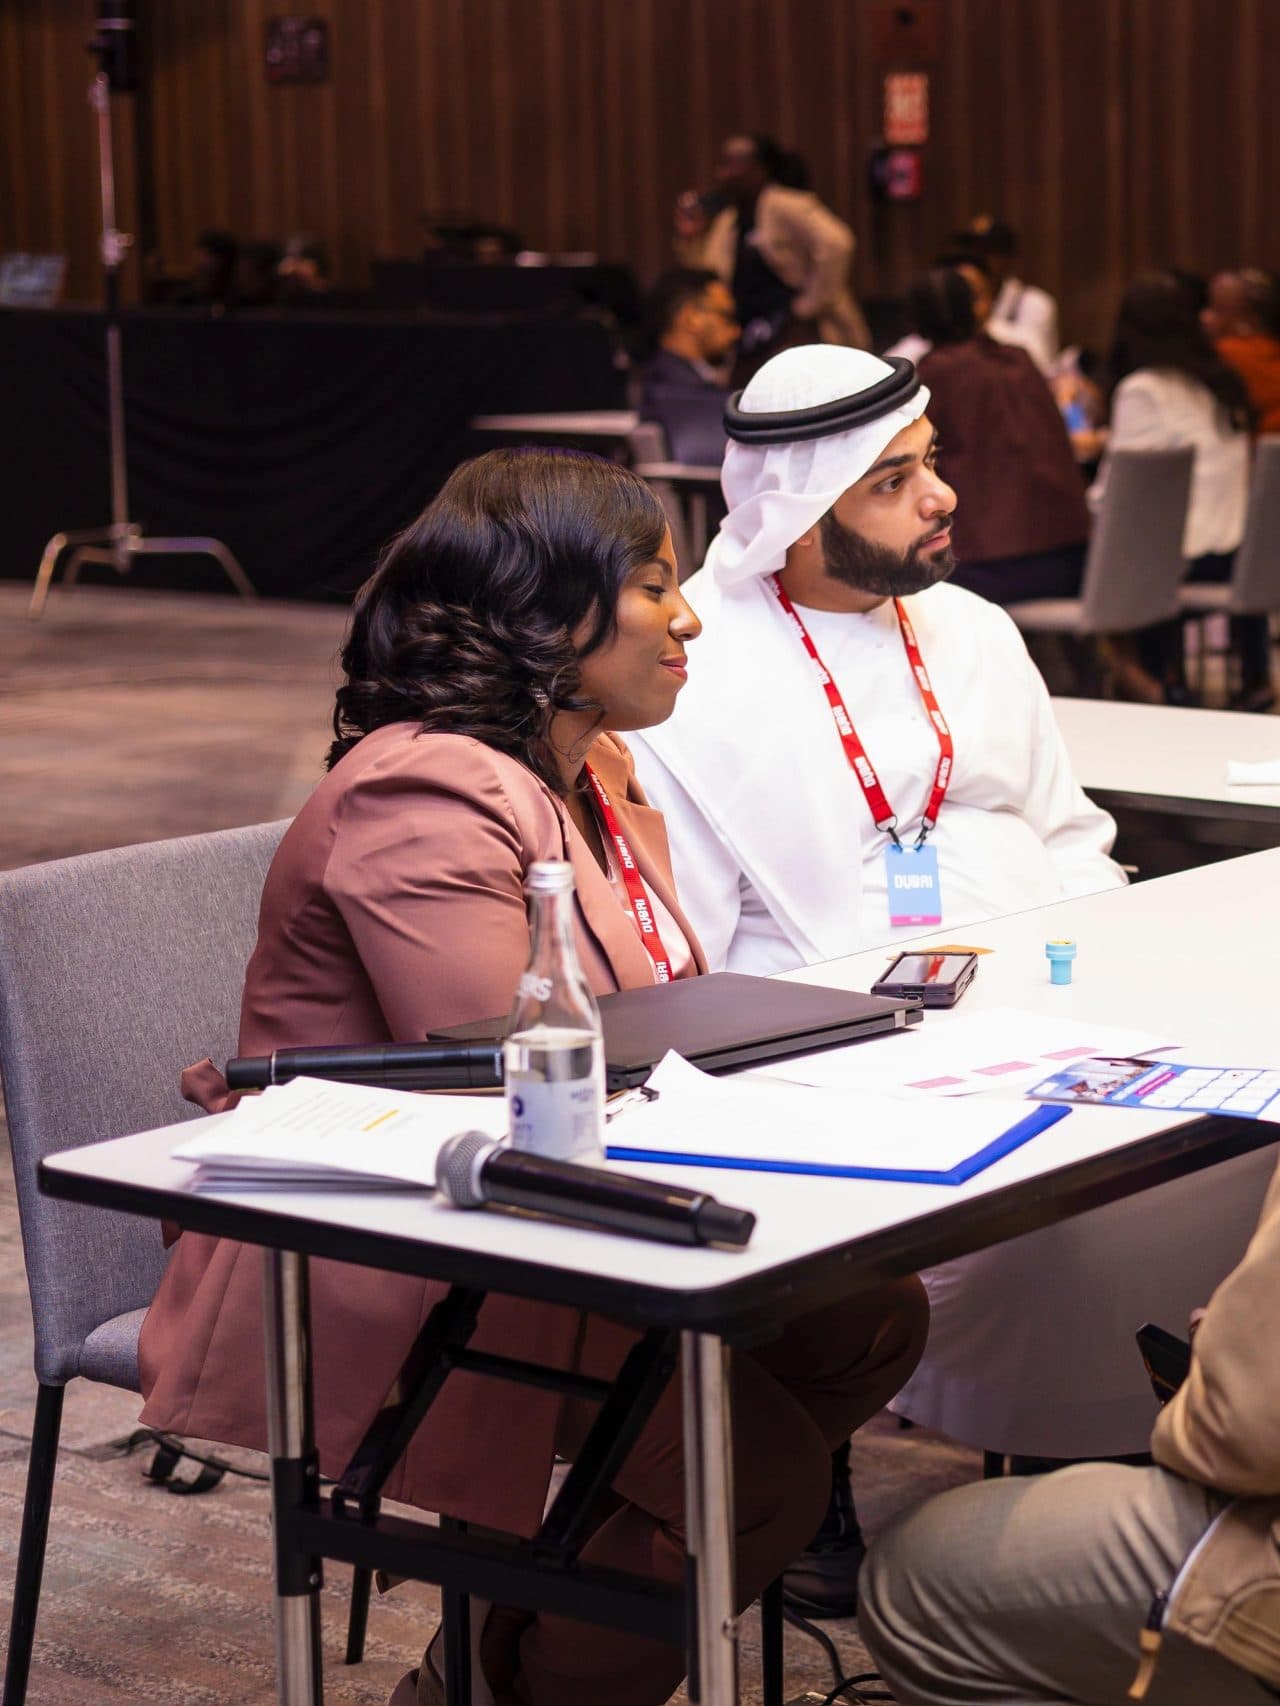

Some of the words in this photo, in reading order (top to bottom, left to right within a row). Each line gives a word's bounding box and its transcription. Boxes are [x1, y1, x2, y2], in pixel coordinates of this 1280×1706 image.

[616, 836, 634, 869] DUBAI
[894, 874, 933, 889] DUBAI
[635, 899, 653, 933] DUBAI
[655, 961, 670, 984] BAI
